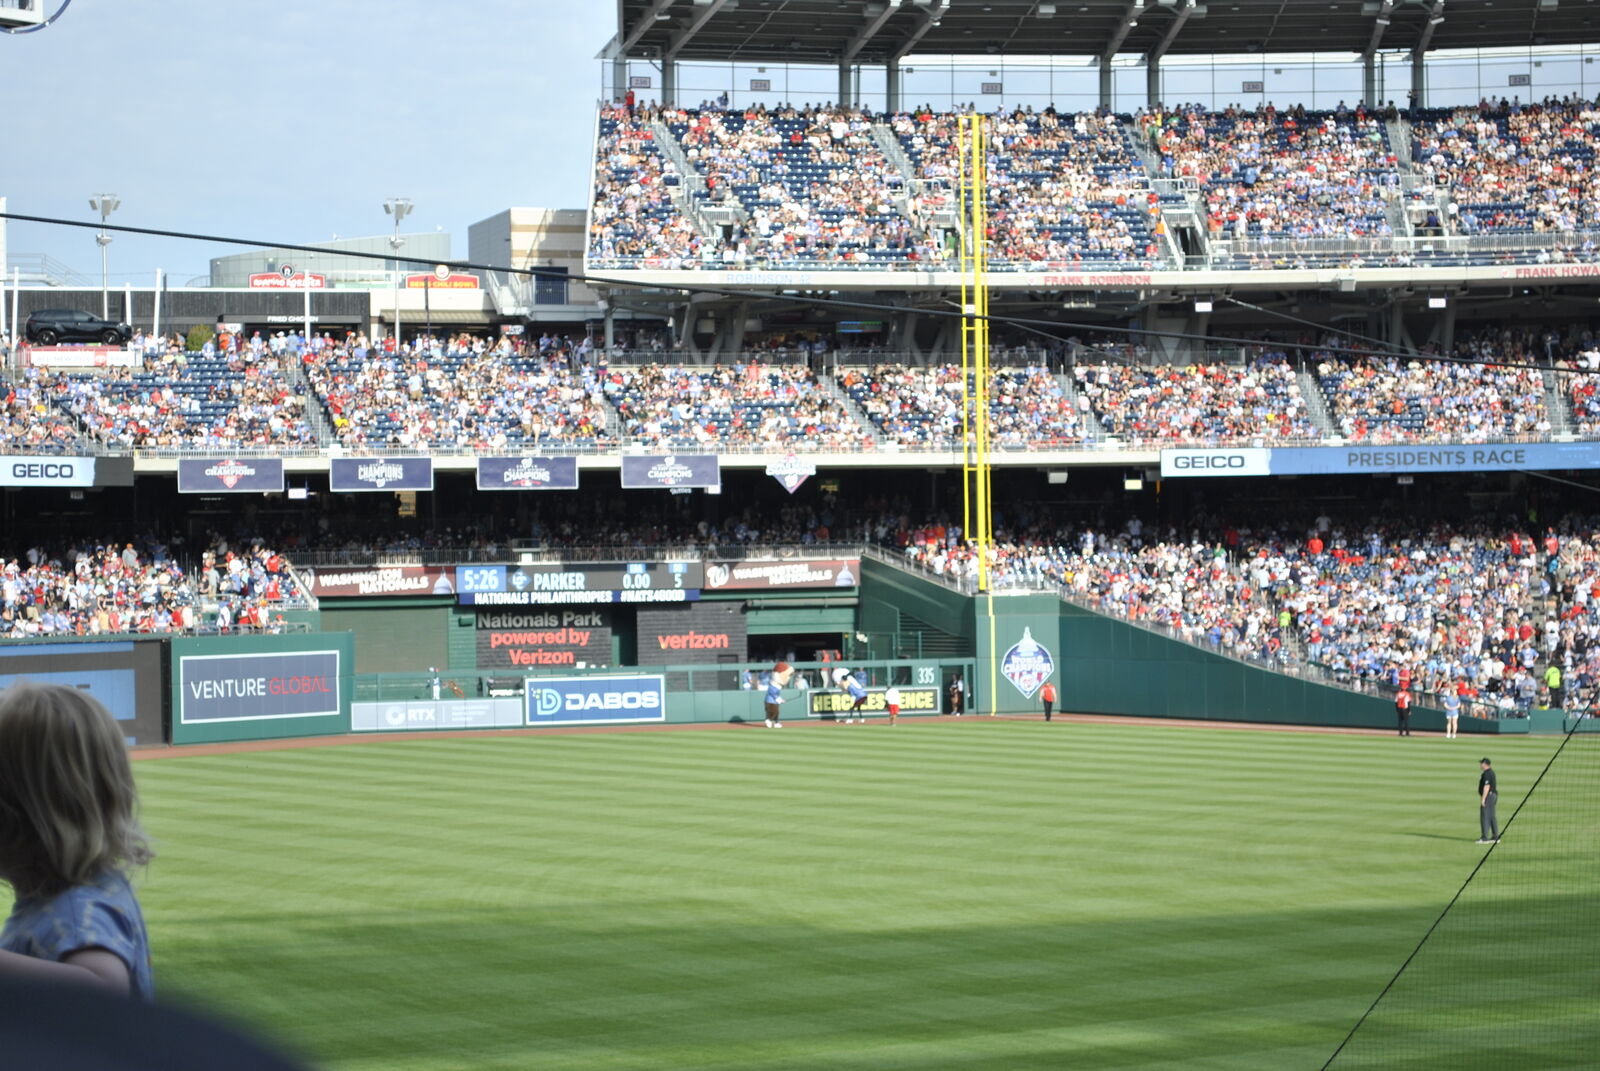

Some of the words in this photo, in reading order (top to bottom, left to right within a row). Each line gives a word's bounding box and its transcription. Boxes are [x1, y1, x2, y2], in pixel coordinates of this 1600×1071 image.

[727, 274, 793, 285] ROBINSON
[1043, 275, 1084, 285] FRANK
[1089, 275, 1152, 285] ROBINSON
[1515, 267, 1558, 278] FRANK
[1174, 455, 1245, 469] GEICO
[1347, 450, 1466, 466] PRESIDENTS
[1473, 449, 1526, 465] RACE
[12, 463, 74, 478] GEICO
[205, 467, 256, 476] CHAMPIONS
[358, 464, 404, 482] CHAMPIONS
[503, 470, 551, 482] CHAMPIONS
[647, 470, 693, 479] CHAMPIONS
[319, 568, 403, 587] WASHINGTON
[464, 569, 499, 591] 5:26
[533, 571, 586, 591] PARKER
[733, 563, 809, 580] WASHINGTON
[769, 569, 833, 585] NATIONALS
[358, 575, 430, 594] NATIONALS
[622, 573, 651, 589] 0.00
[674, 573, 683, 588] 5
[474, 592, 529, 605] NATIONALS
[530, 590, 613, 604] PHILANTHROPIES
[477, 611, 559, 628] Nationals
[562, 610, 603, 627] Park
[491, 628, 567, 648] powered
[569, 628, 591, 647] by
[657, 630, 729, 649] verizon
[508, 648, 575, 665] Verizon
[917, 667, 935, 684] 335
[190, 677, 266, 699] VENTURE
[269, 674, 332, 696] GLOBAL
[565, 690, 660, 711] DABOS
[407, 708, 436, 721] RTX
